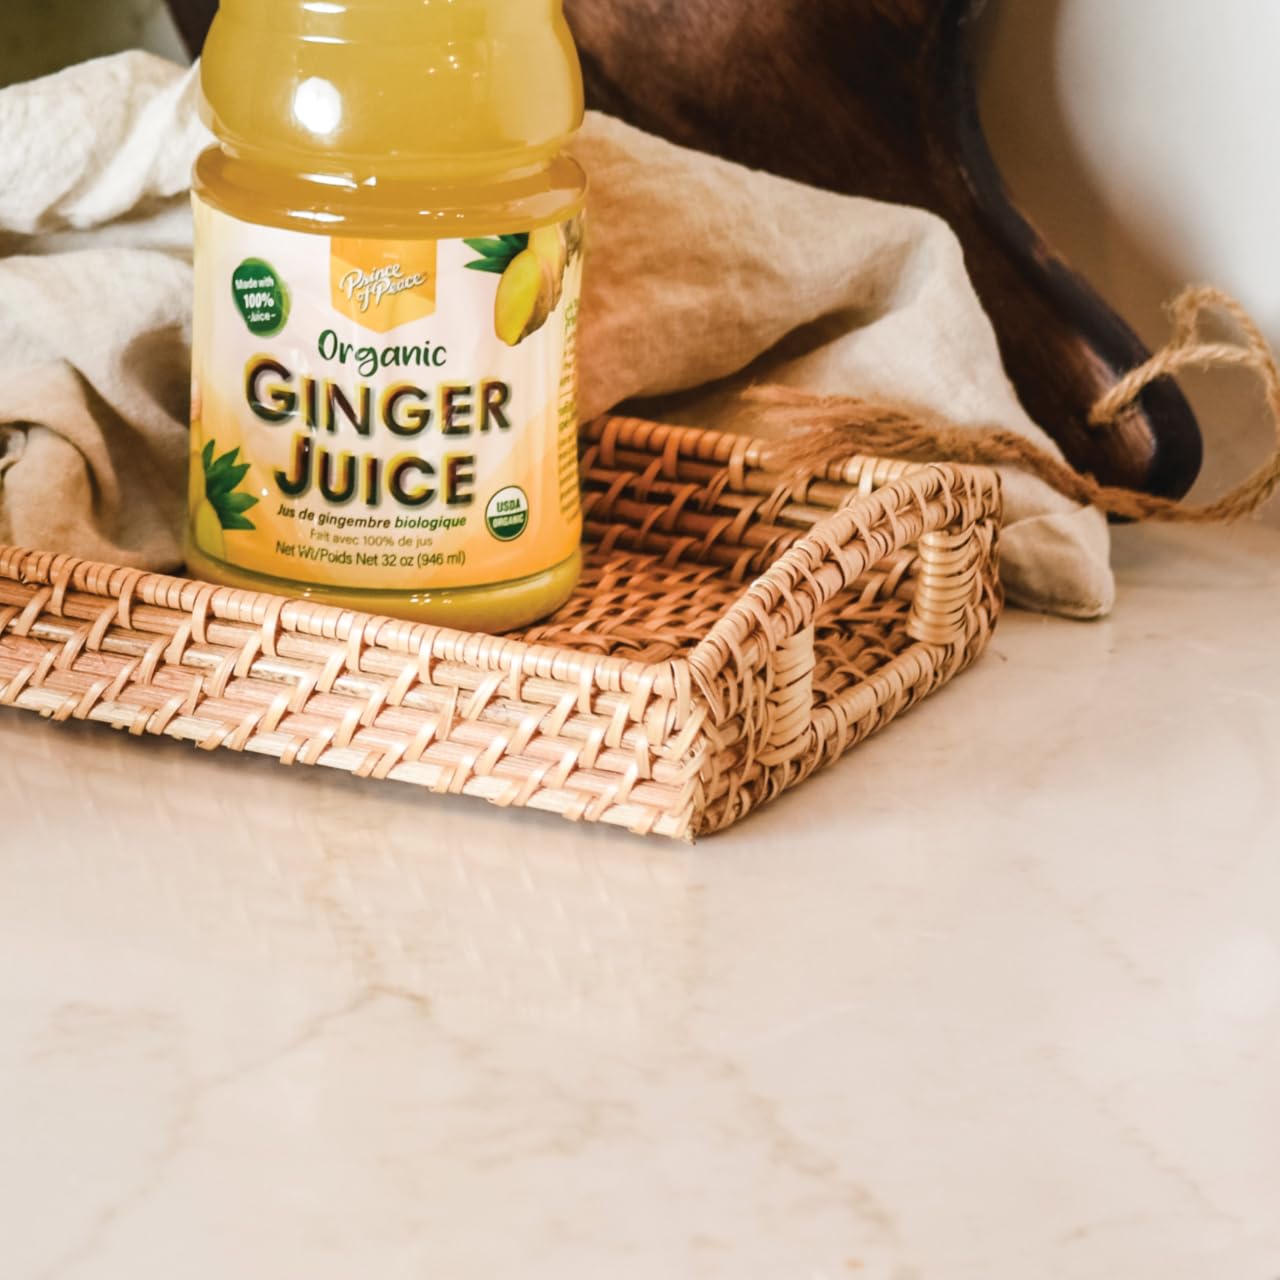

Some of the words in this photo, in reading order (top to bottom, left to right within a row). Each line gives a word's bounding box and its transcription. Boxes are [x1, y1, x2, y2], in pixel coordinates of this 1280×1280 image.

[235, 278, 257, 290] Made
[258, 275, 274, 288] with
[339, 264, 404, 300] Prince
[356, 284, 373, 312] of
[372, 272, 427, 306] Peace
[243, 292, 275, 309] 100%
[318, 329, 447, 377] Organic
[245, 353, 511, 436] GINGER
[274, 433, 474, 507] JUICE
[277, 504, 296, 518] Jus
[298, 508, 315, 521] de
[318, 512, 391, 529] gingembre
[394, 516, 467, 532] biologique
[496, 498, 521, 513] USDA
[310, 528, 329, 542] Fait
[332, 534, 359, 545] avec
[363, 535, 395, 547] 100%
[398, 535, 413, 546] de
[416, 536, 433, 549] jus
[276, 540, 296, 557] Net
[298, 544, 353, 565] Wt/Poids
[356, 552, 378, 567] Net
[382, 553, 397, 567] 32
[399, 555, 414, 567] oz
[417, 551, 444, 569] (946
[447, 550, 466, 567] ml)
